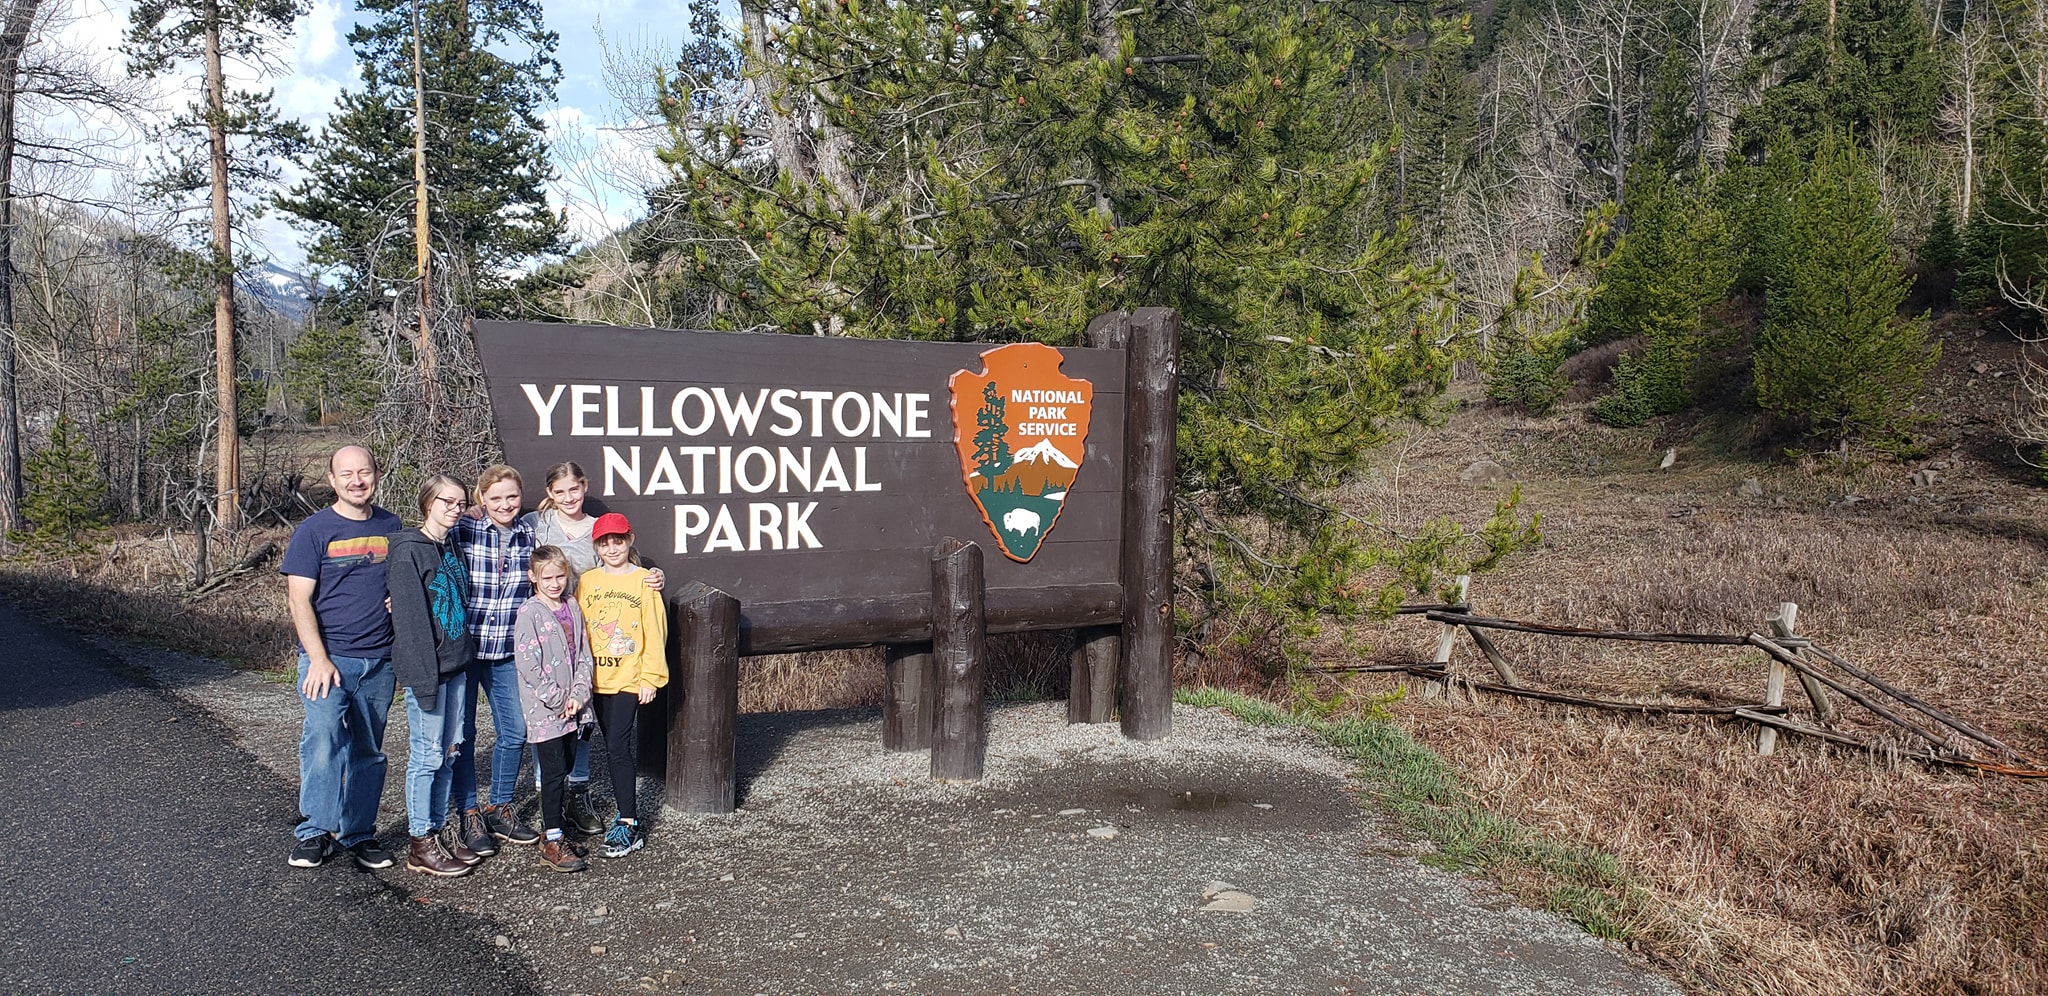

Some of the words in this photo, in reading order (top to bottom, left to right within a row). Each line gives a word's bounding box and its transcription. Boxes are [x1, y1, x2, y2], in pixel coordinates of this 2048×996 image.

[1011, 389, 1085, 404] NATIONAL
[518, 383, 932, 438] YELLOWSTONE
[1029, 406, 1067, 420] PARK
[1018, 422, 1077, 436] SERVICE
[602, 445, 882, 497] NATIONAL
[673, 501, 824, 555] PARK
[604, 589, 642, 608] obviously
